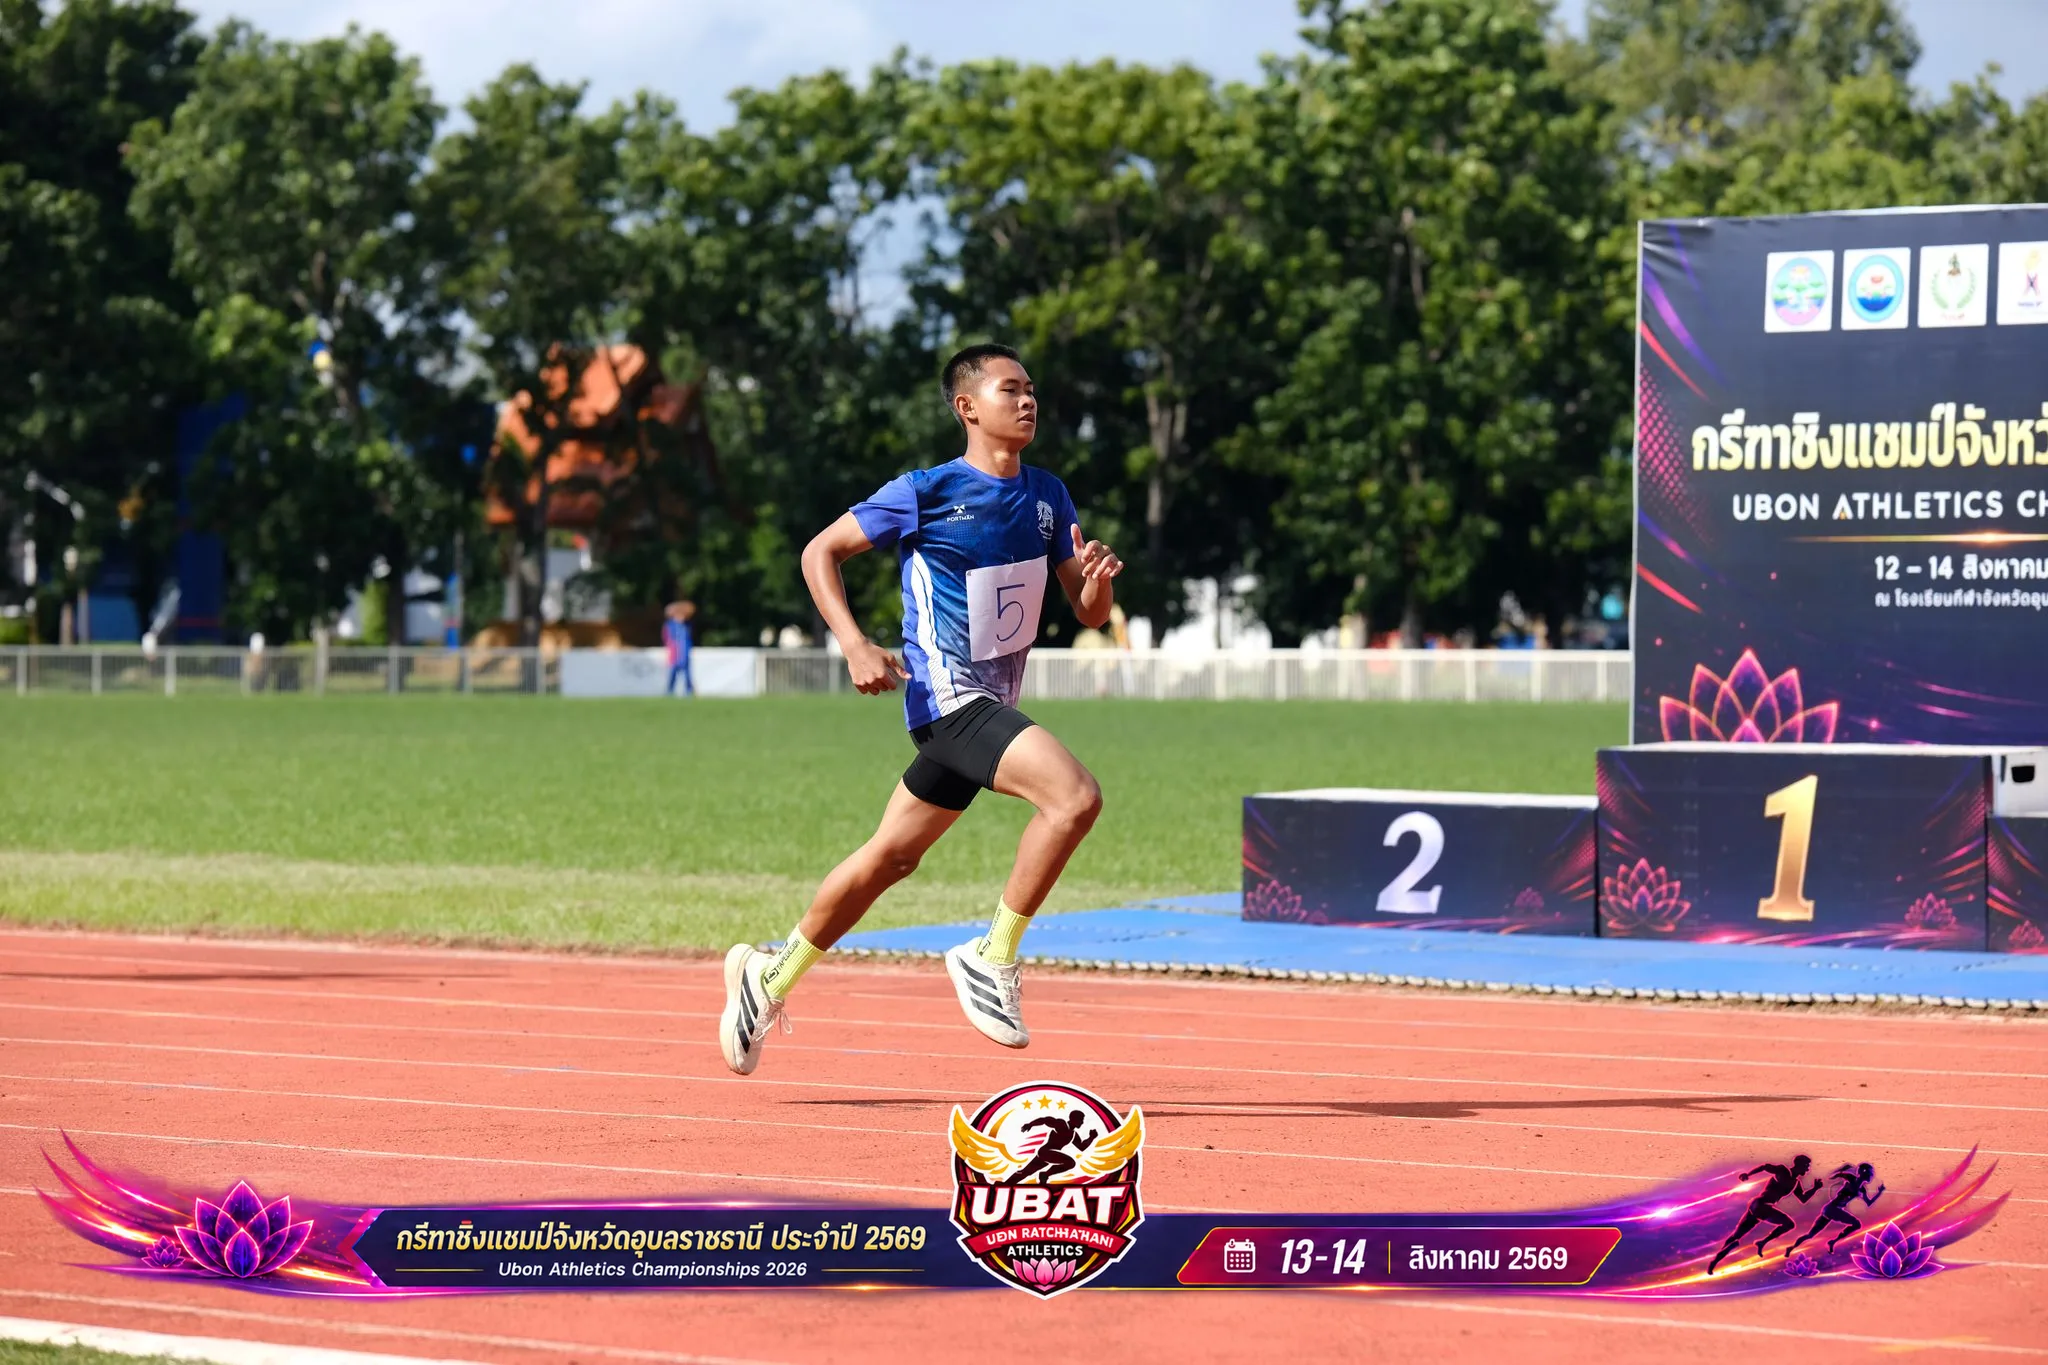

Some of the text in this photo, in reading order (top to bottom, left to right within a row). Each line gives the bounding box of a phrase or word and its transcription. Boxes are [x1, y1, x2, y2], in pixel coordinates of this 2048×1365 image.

[1732, 492, 1819, 521] UBON
[1832, 490, 2004, 520] ATHLETICS
[1874, 555, 1900, 581] 12
[1928, 555, 1954, 580] 14
[996, 583, 1026, 642] 5
[1375, 810, 1445, 915] 2
[1756, 774, 1818, 922] 1
